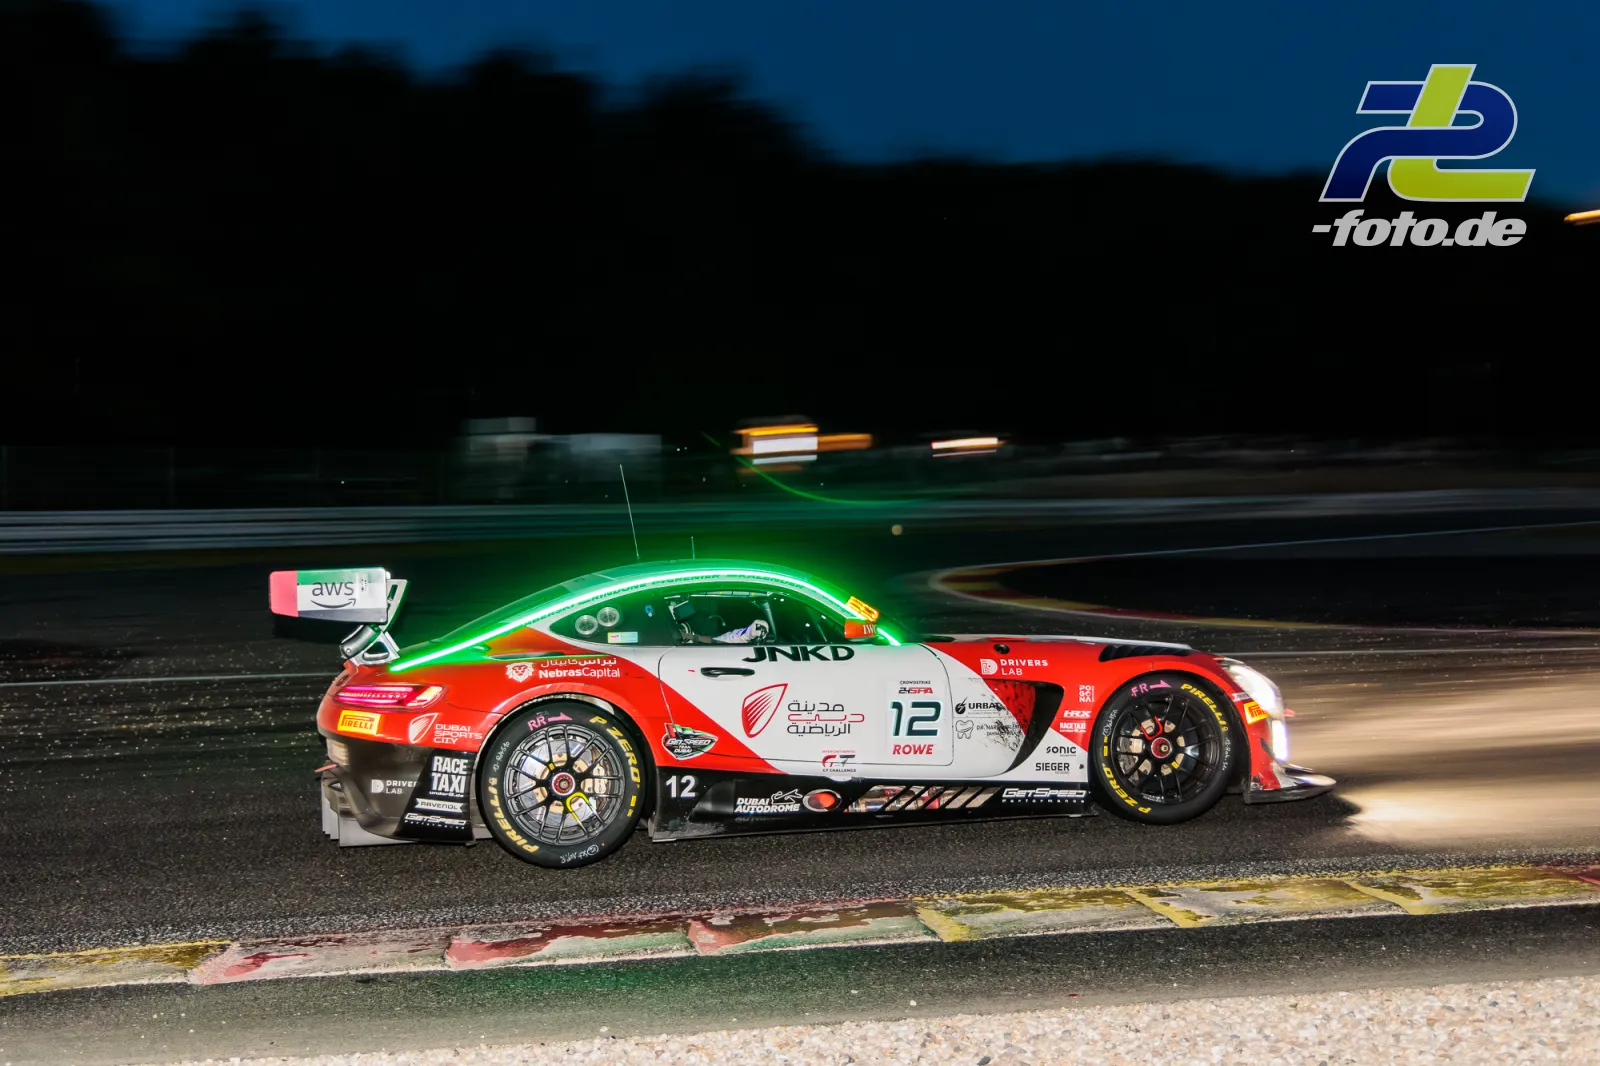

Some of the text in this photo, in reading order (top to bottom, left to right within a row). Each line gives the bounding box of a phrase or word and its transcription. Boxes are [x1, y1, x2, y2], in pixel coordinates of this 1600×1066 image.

[312, 581, 354, 596] aws
[741, 645, 855, 662] JNKD
[1000, 659, 1048, 667] DRIVERS
[1001, 668, 1023, 676] LAB
[1132, 683, 1149, 696] FR
[788, 700, 845, 714] مدينة
[1180, 683, 1227, 726] PIRELLI
[341, 715, 375, 730] PIRELLI
[527, 714, 547, 731] RR
[889, 700, 943, 738] 12
[434, 731, 483, 739] SPORTS
[435, 724, 471, 732] DUBAI
[787, 722, 851, 737] الرياضية
[589, 715, 641, 784] P ZERO
[892, 744, 934, 755] ROWE
[433, 756, 468, 774] RACE
[1035, 762, 1070, 771] SIEGER
[431, 773, 465, 793] TAXI
[665, 775, 697, 798] 12
[1104, 767, 1139, 807] ZERO
[420, 801, 458, 810] RAVENOL
[734, 804, 801, 813] AUTODROME
[1138, 806, 1152, 814] P
[488, 786, 540, 853] PIRELLI
